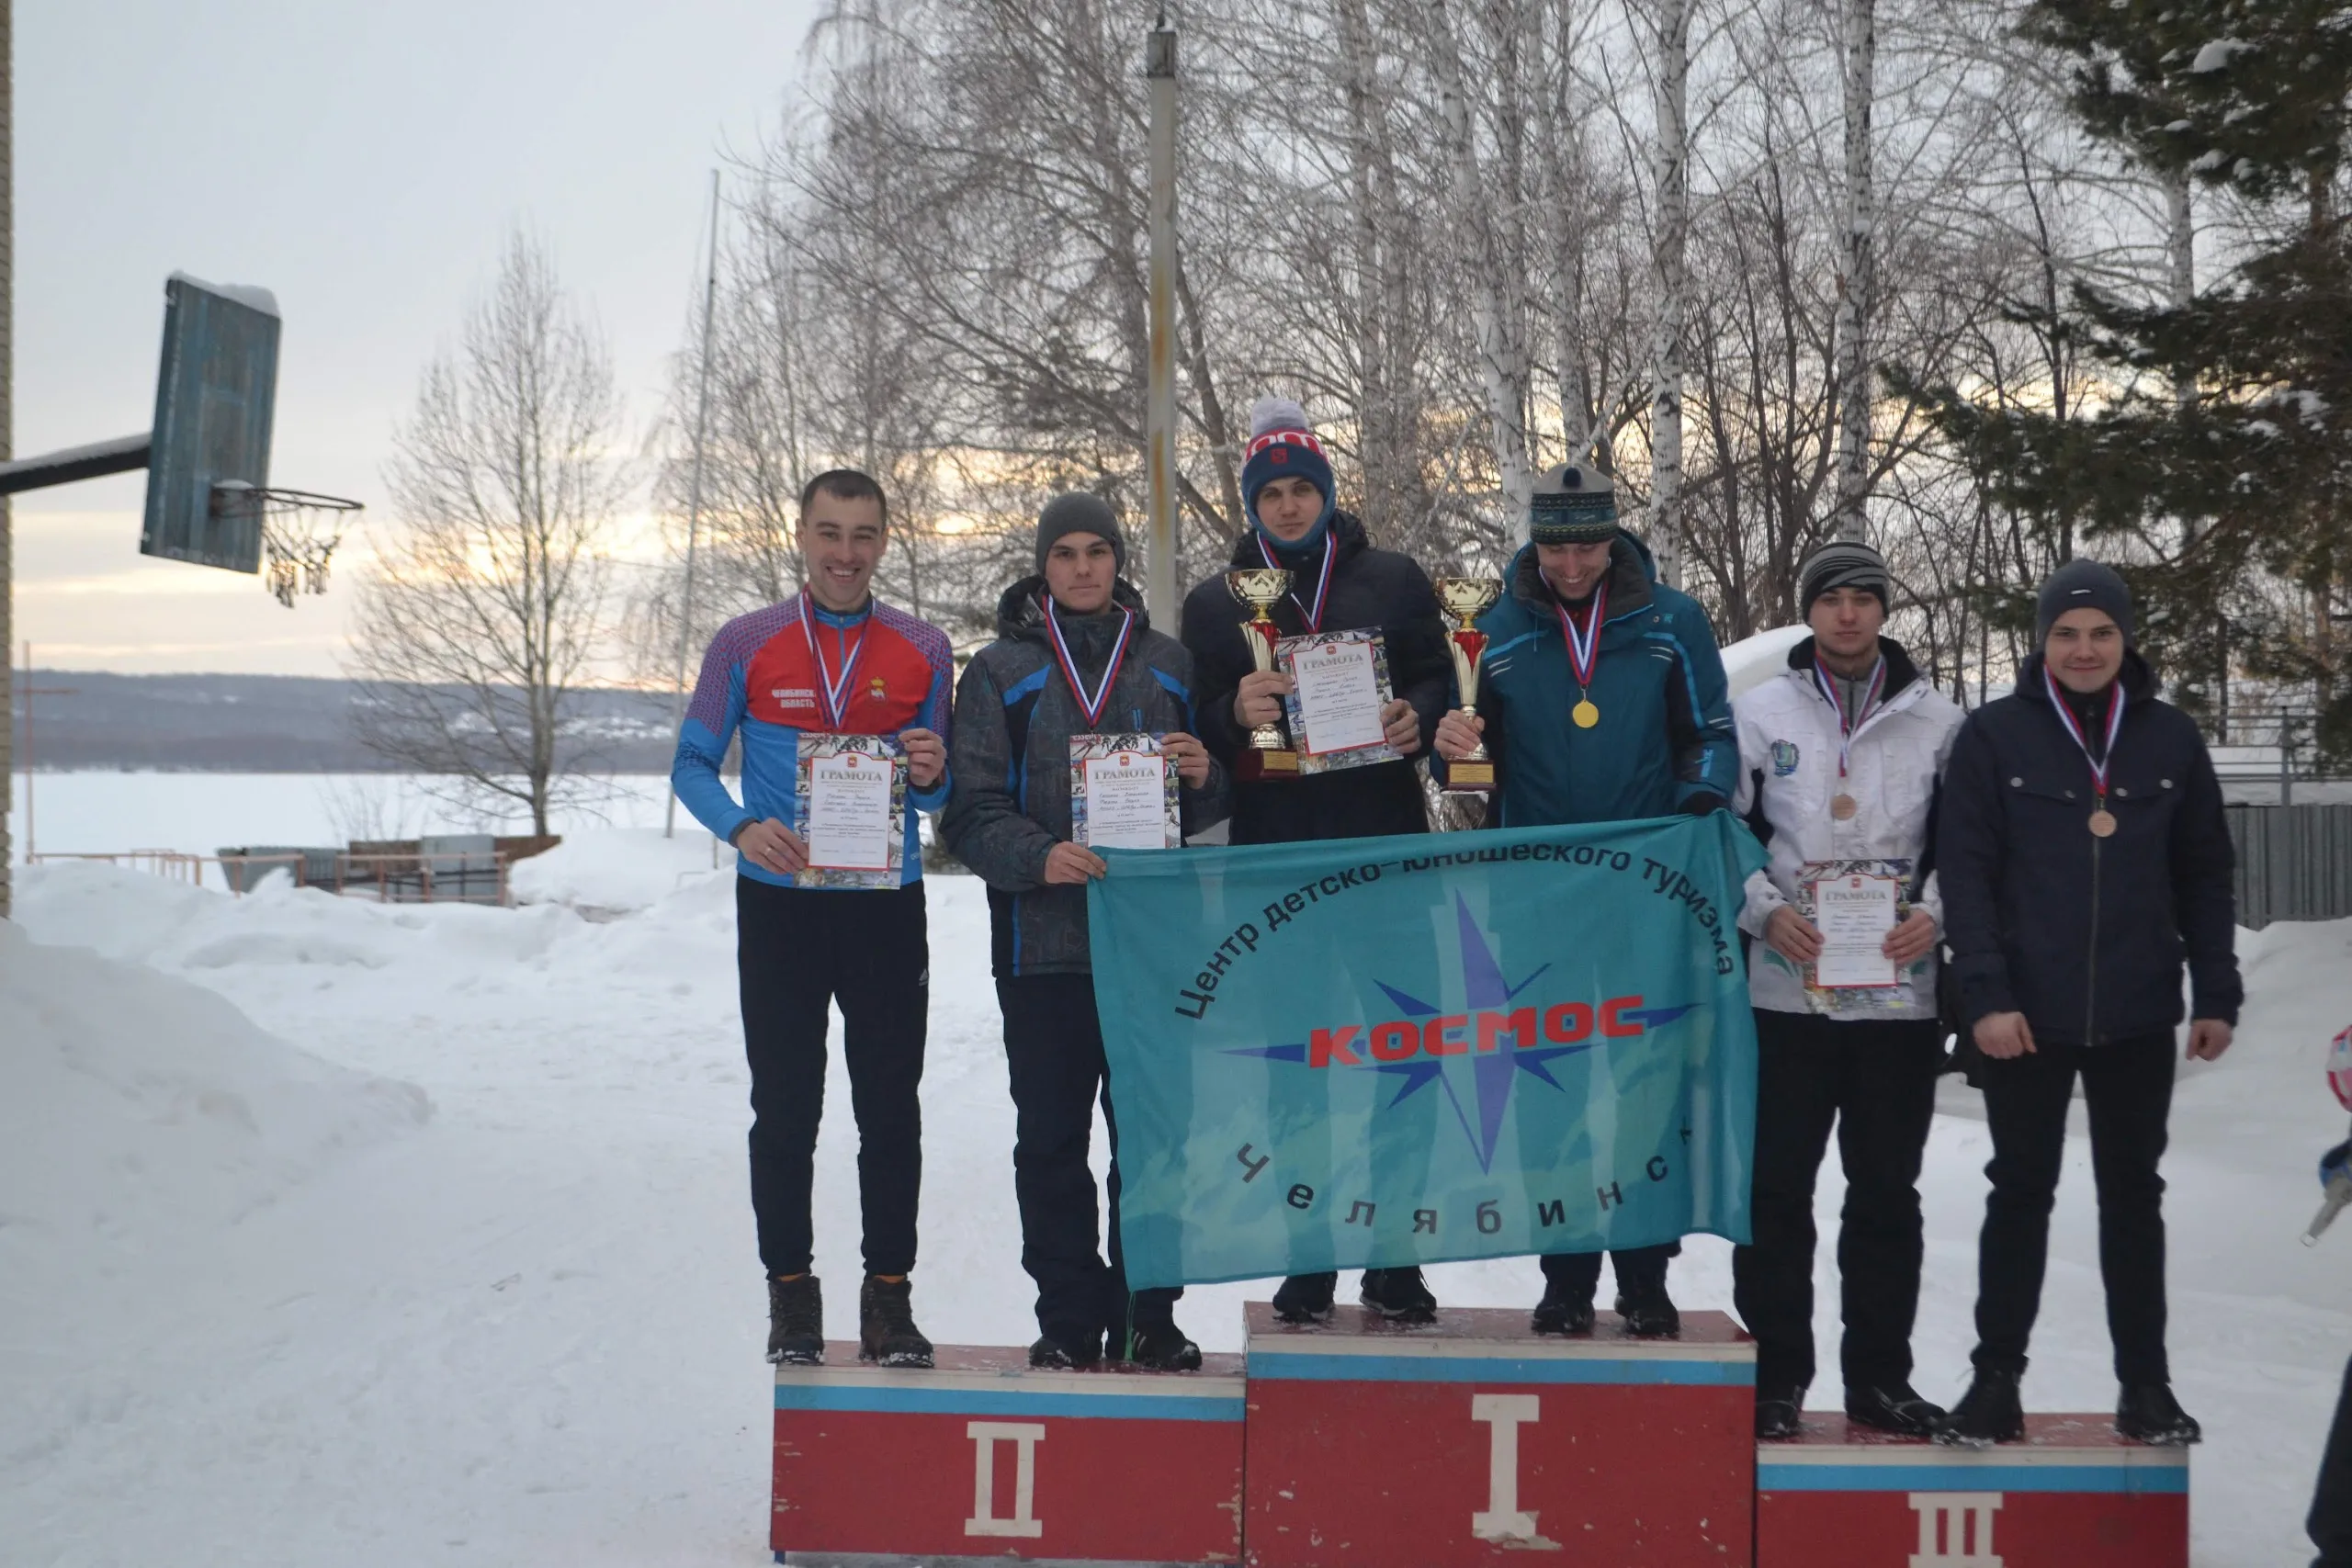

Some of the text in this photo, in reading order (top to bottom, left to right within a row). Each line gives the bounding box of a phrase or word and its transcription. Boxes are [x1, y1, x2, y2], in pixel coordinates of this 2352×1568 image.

[1303, 653, 1363, 670] ГРАМОТА
[820, 770, 882, 781] ГРАМОТА
[1094, 767, 1155, 780] ГРАМОТА
[1826, 891, 1886, 900] ГРАМОТА
[1175, 922, 1260, 1020] Центр
[1643, 857, 1734, 976] туризма
[1309, 995, 1644, 1068] КОСМОС
[965, 1421, 1046, 1538] II
[1472, 1393, 1540, 1539] I
[1908, 1491, 2004, 1568] III
